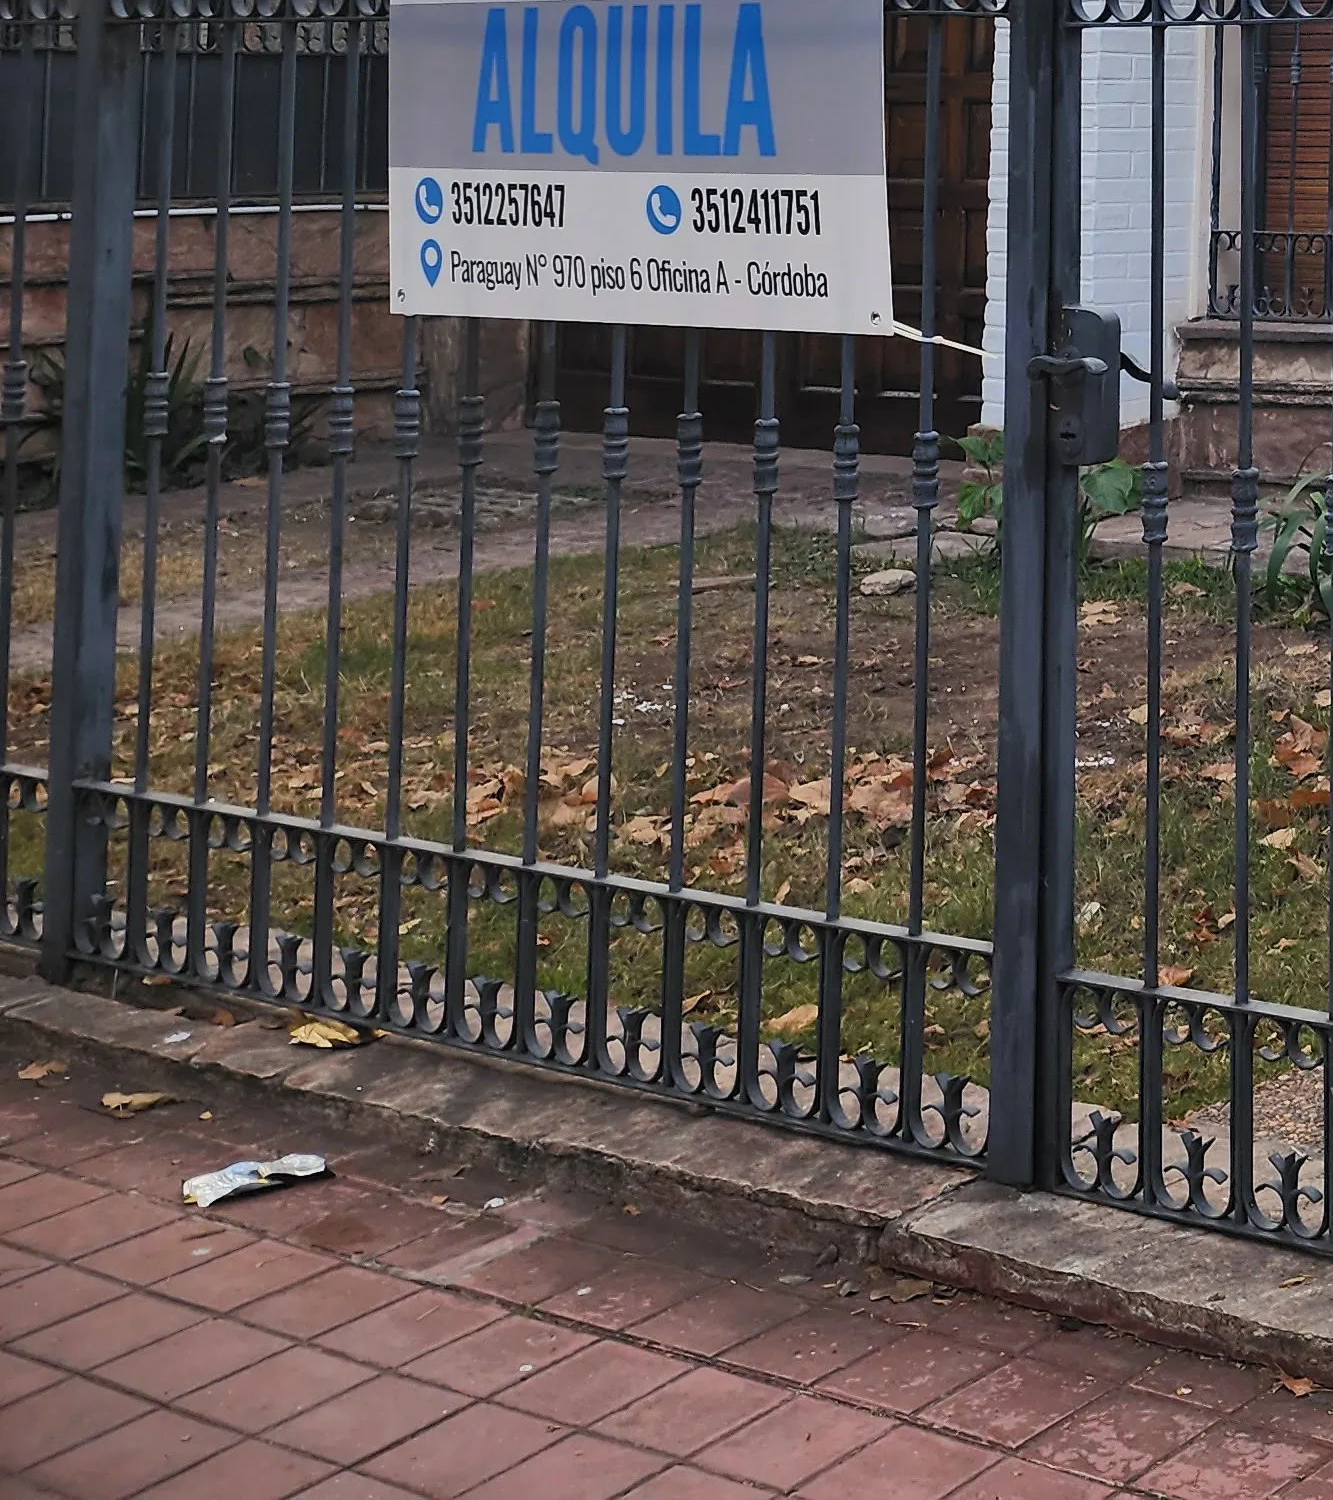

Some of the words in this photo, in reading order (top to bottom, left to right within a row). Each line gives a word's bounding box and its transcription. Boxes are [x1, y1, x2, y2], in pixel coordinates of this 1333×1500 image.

[472, 2, 777, 166] ALQUILA
[451, 181, 566, 228] 3512257647
[691, 187, 822, 236] 3512411751
[450, 250, 522, 291] Paraguay
[525, 253, 548, 287] N°
[552, 255, 586, 288] 970
[590, 258, 626, 296] piso
[629, 257, 642, 291] 6
[647, 258, 711, 294] Oficina
[716, 261, 730, 295] A
[747, 261, 829, 298] Córdoba
